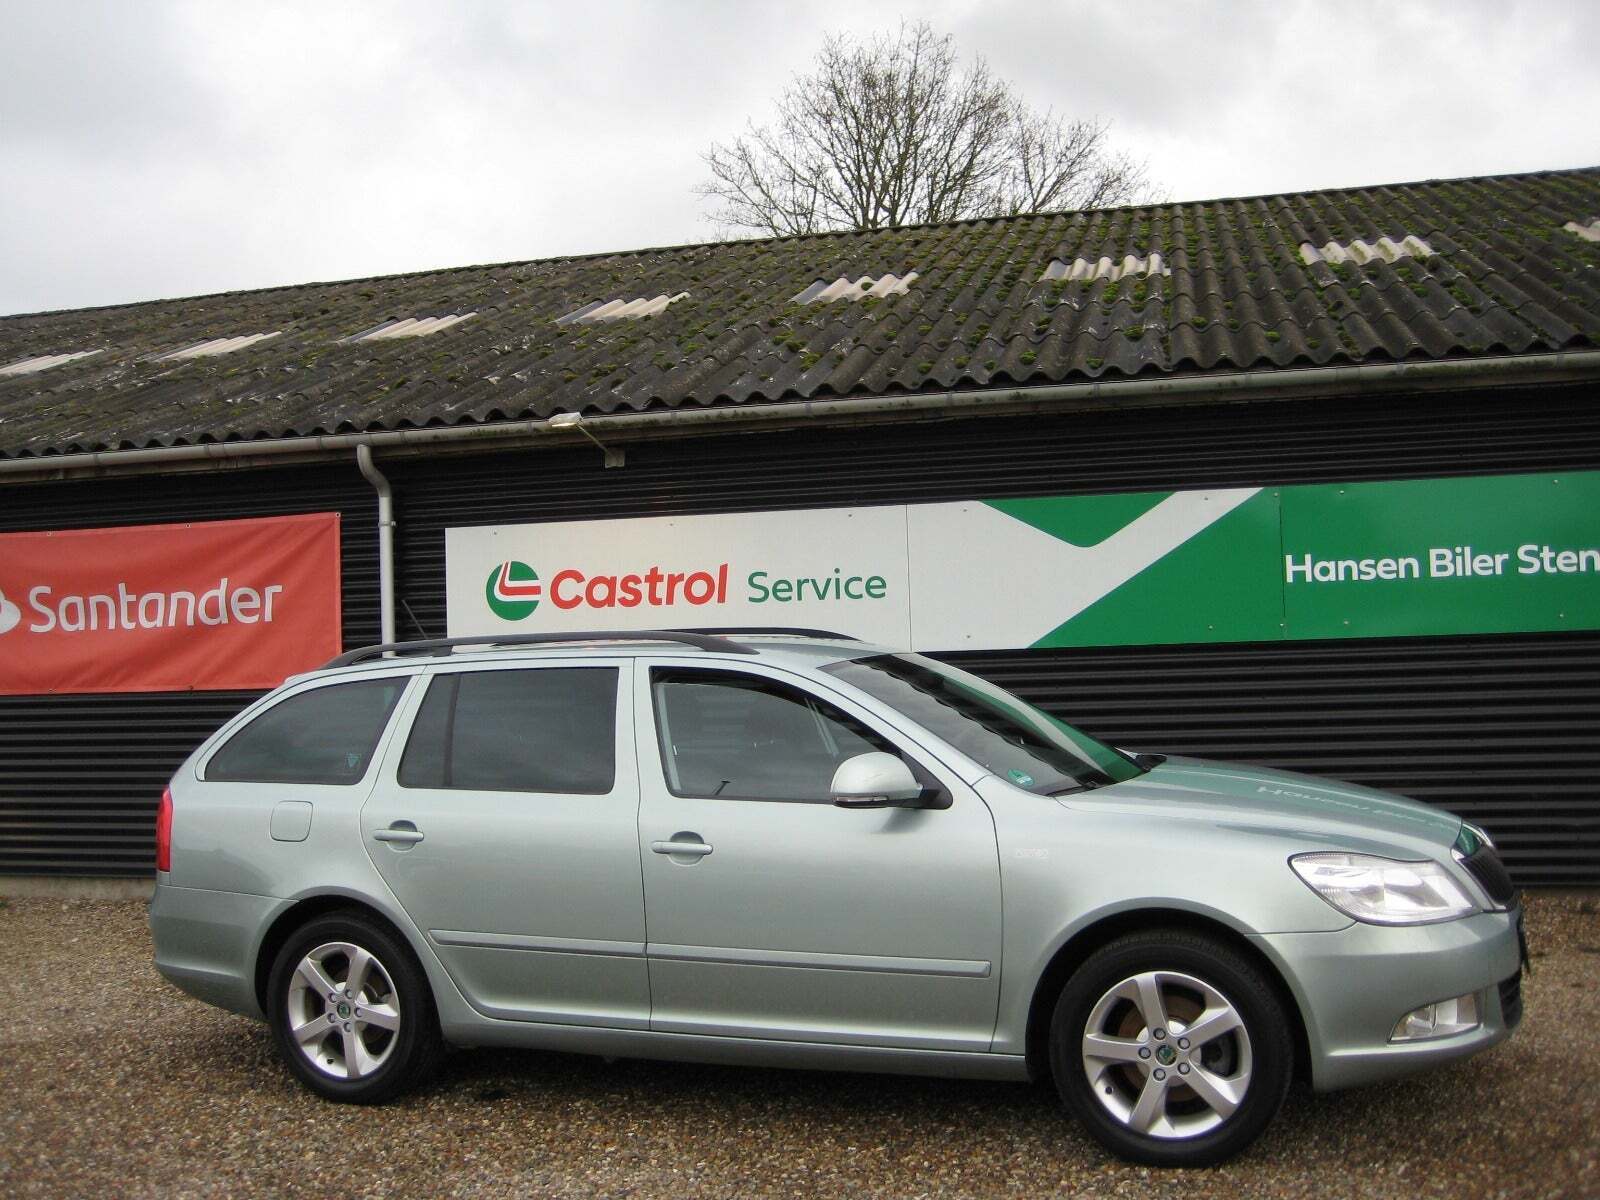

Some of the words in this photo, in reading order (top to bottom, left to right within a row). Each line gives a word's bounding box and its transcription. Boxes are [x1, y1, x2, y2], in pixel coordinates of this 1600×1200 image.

[550, 563, 728, 609] Castrol
[748, 568, 886, 603] Service
[1285, 553, 1419, 583] Hansen
[1429, 546, 1509, 577] Biler
[1516, 544, 1600, 574] Sten
[29, 577, 283, 633] Santander
